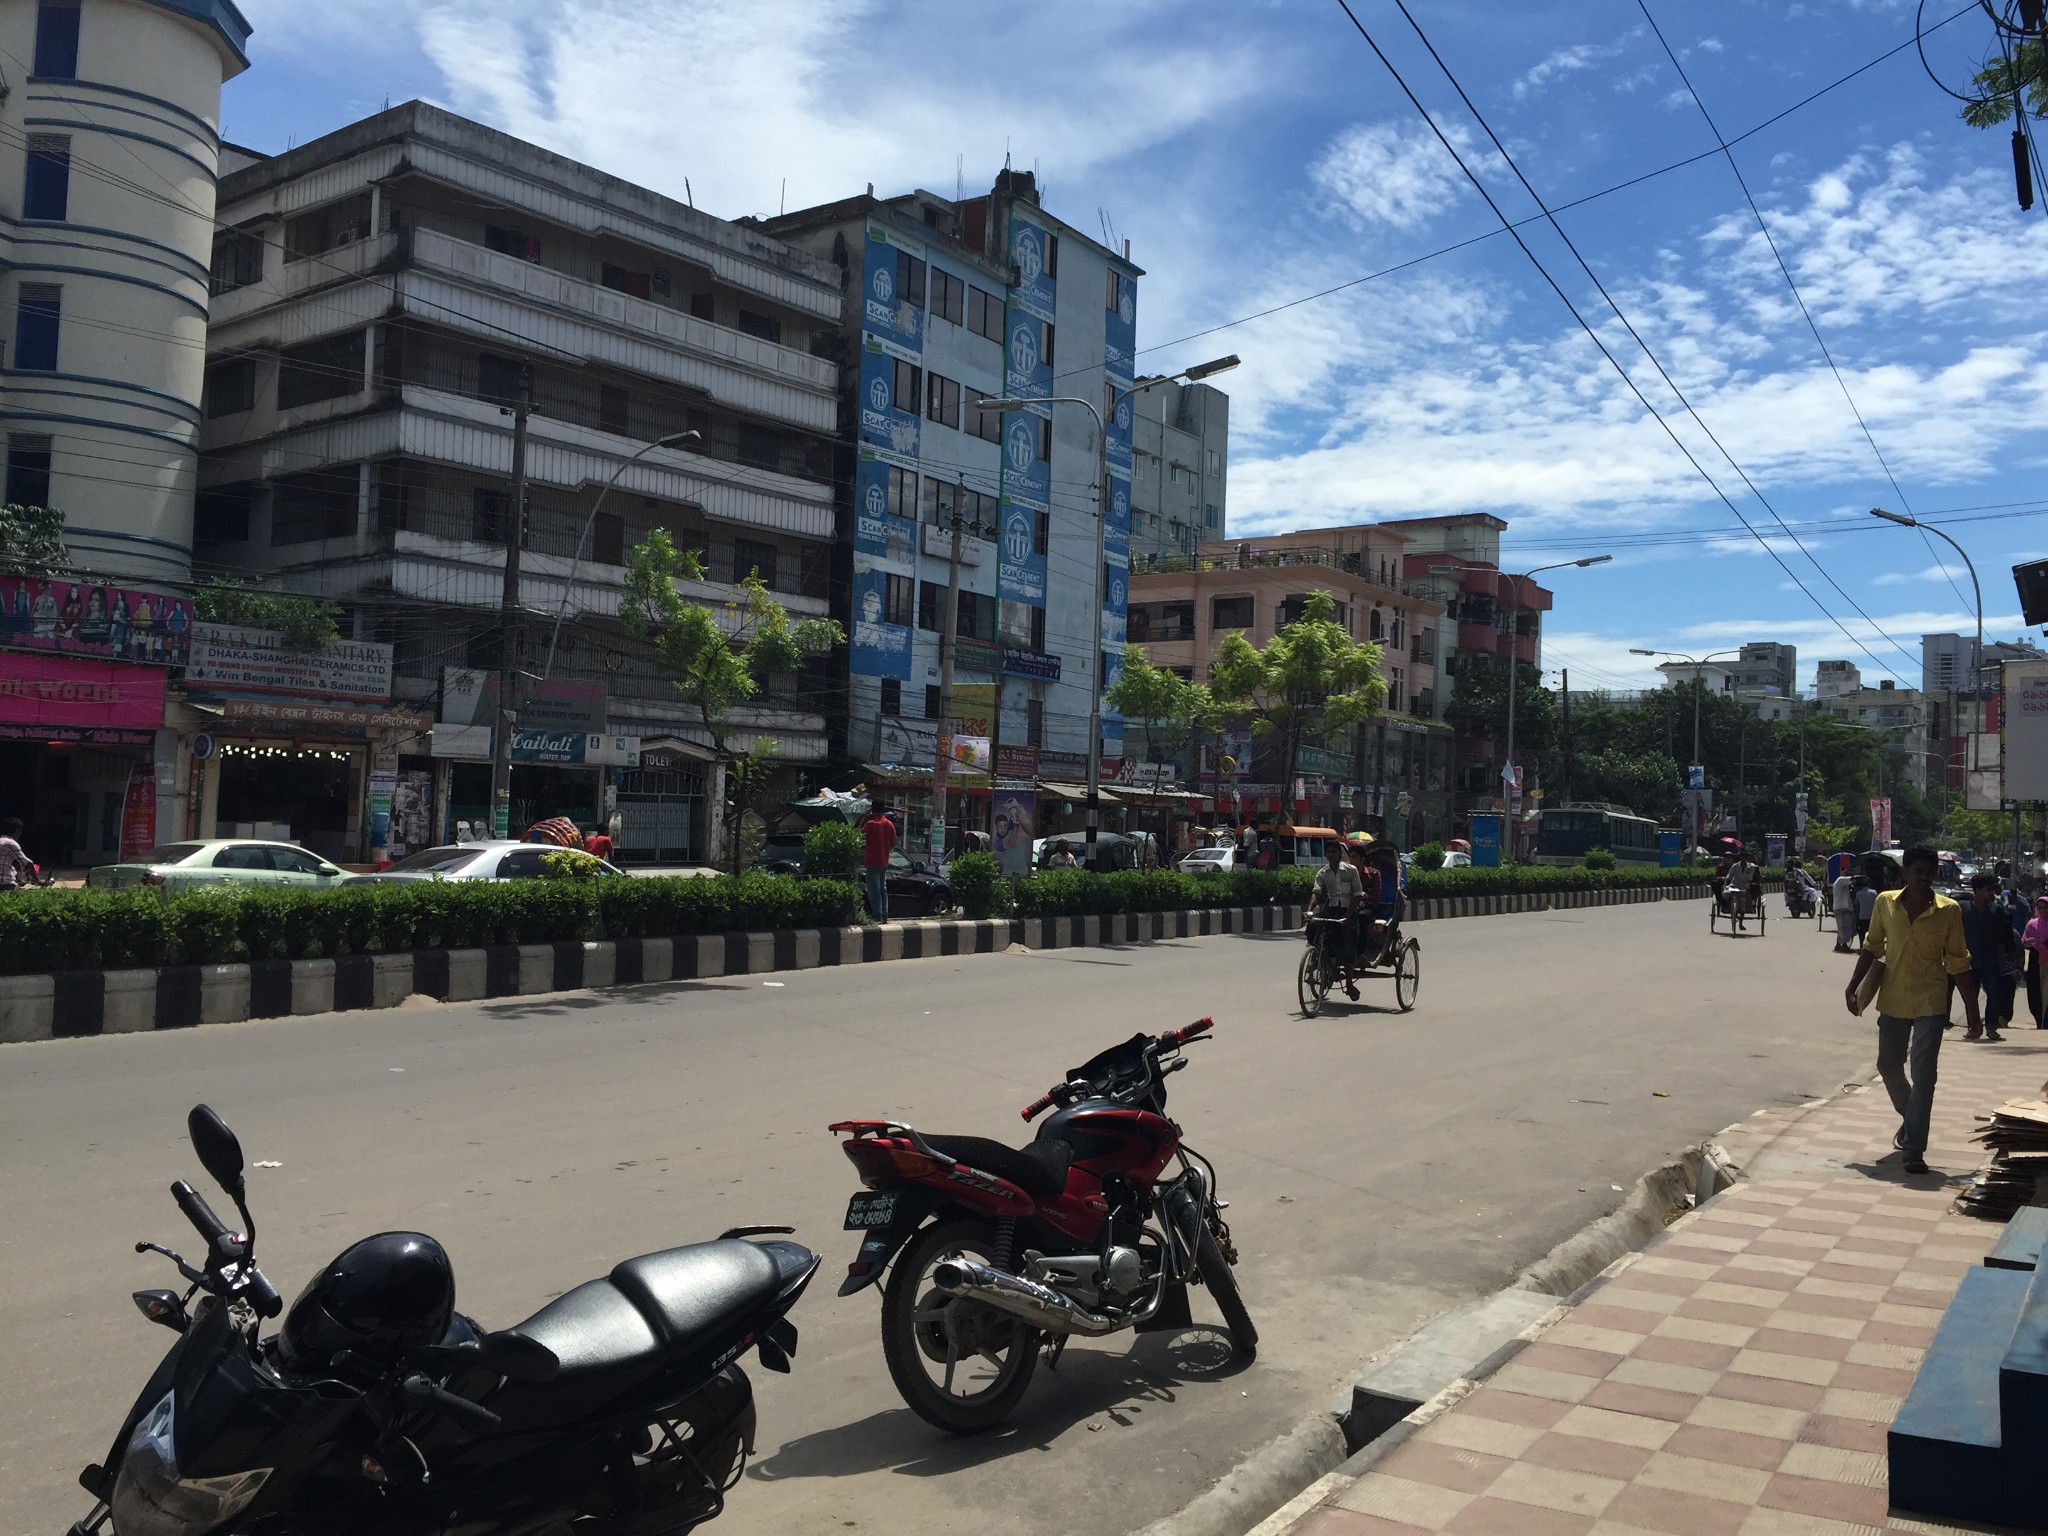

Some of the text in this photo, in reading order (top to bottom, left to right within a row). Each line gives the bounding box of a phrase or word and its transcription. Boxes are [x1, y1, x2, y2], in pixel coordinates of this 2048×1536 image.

[208, 648, 309, 667] DHAKA-SHANGHAI
[311, 659, 364, 673] CERAMICS
[215, 669, 239, 680] Win
[243, 672, 285, 685] Bengal
[289, 677, 315, 687] Tiles
[318, 680, 327, 688] &
[330, 681, 385, 694] Sanitation
